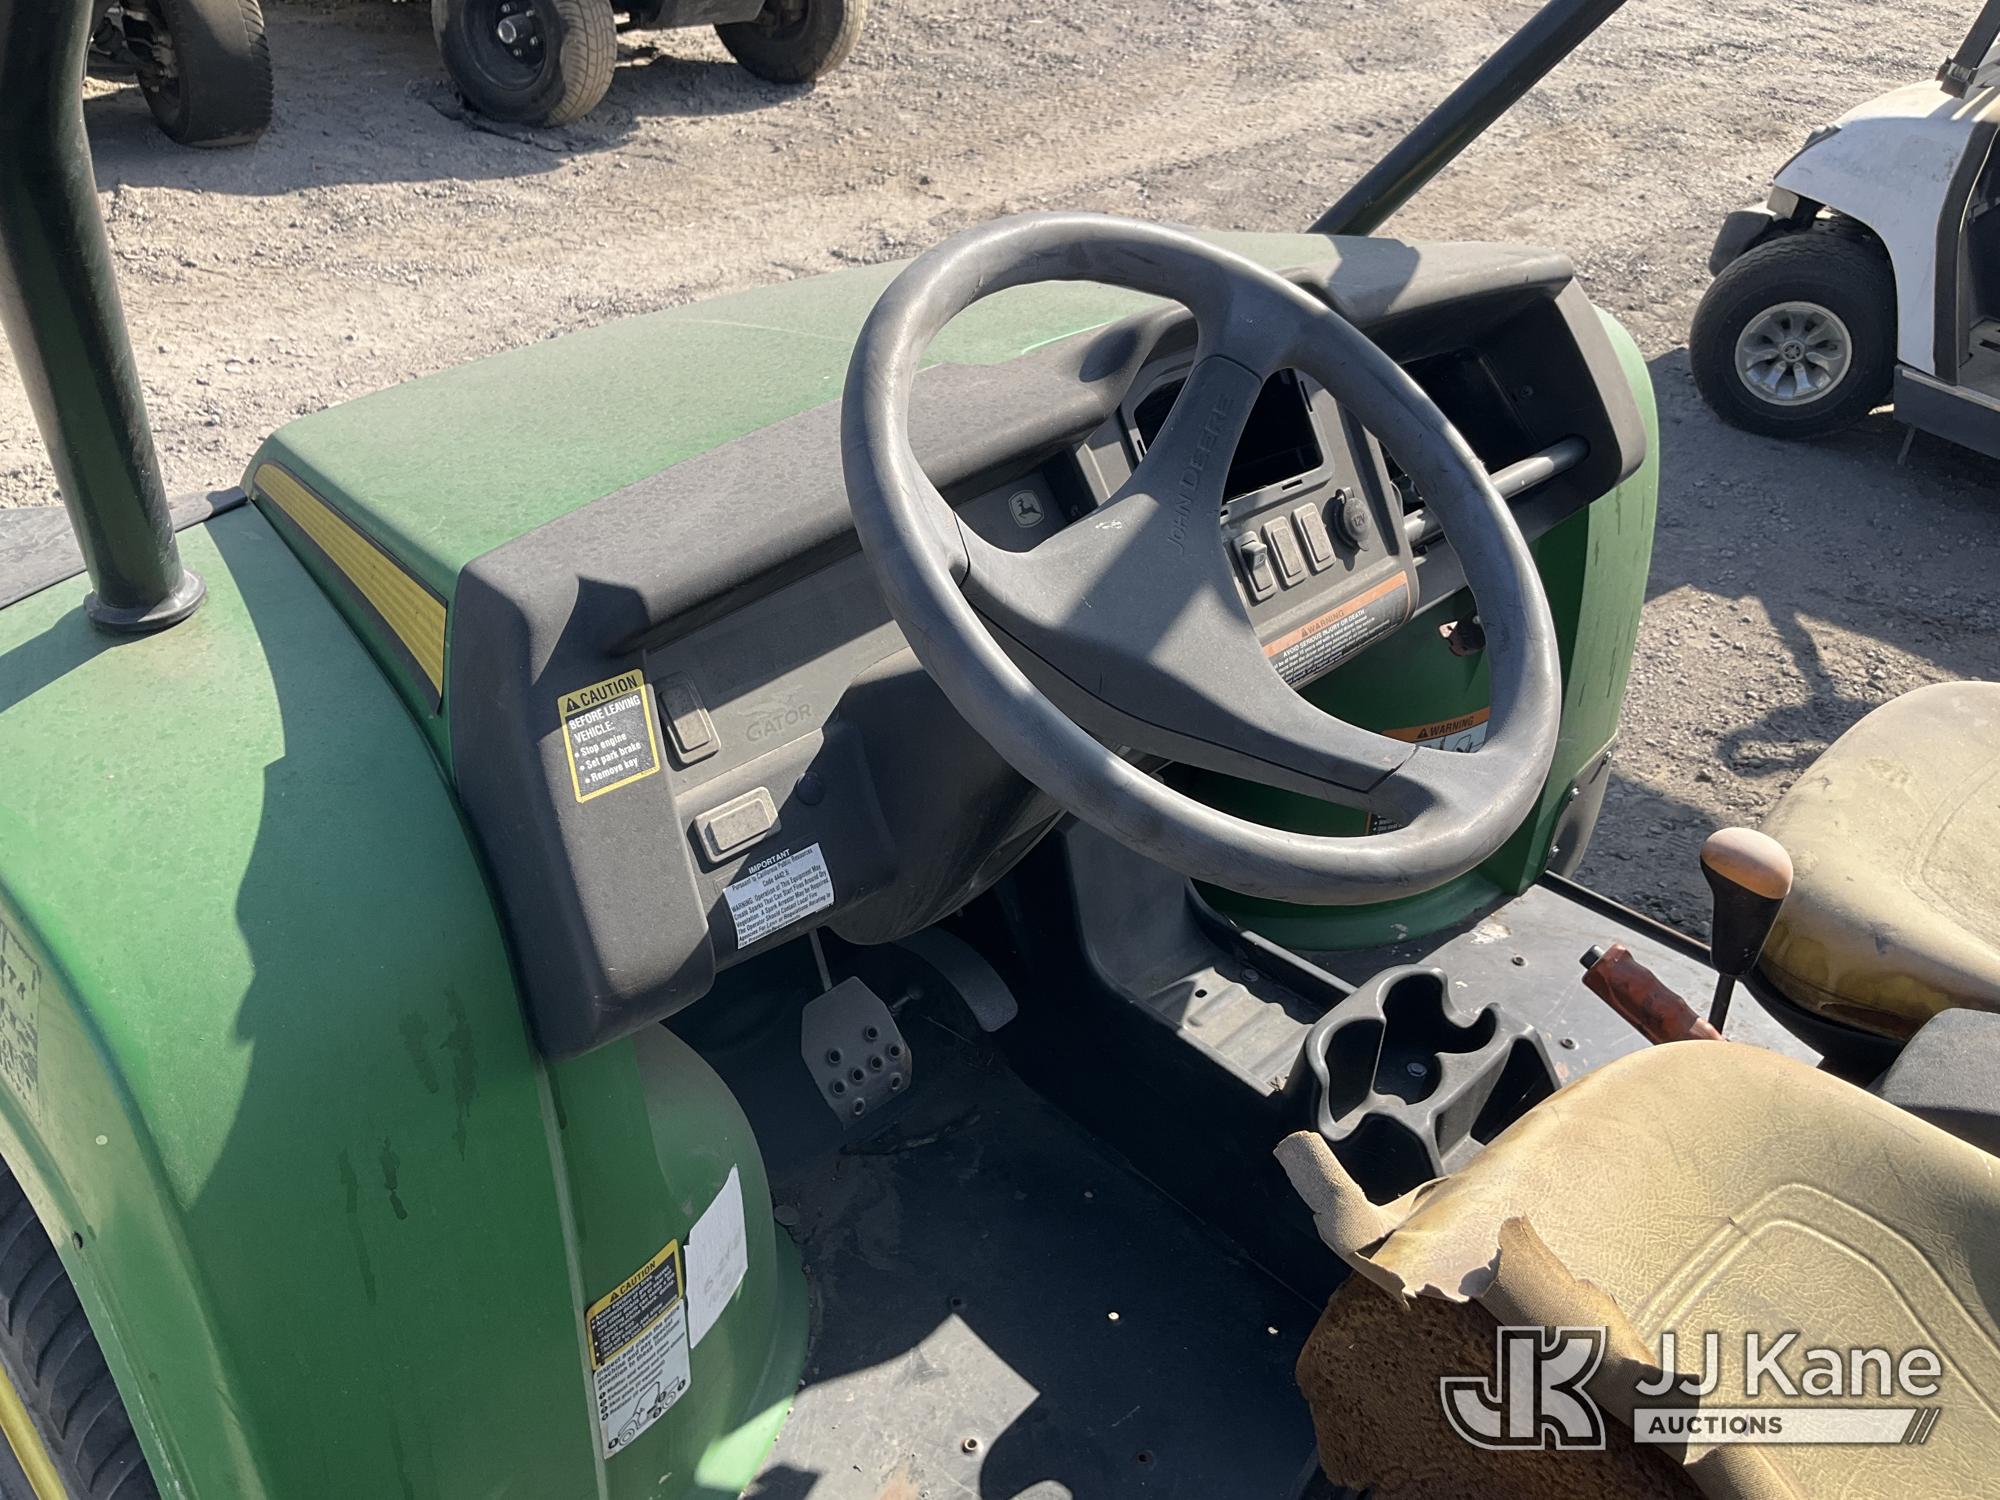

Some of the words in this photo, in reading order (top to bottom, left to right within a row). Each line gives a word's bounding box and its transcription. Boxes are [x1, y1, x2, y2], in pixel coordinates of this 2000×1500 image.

[1282, 646, 1298, 656] AVOID
[1298, 633, 1322, 647] SERIOUS
[1321, 623, 1340, 634] INJURY
[1348, 609, 1365, 620] DEATH
[1307, 609, 1345, 635] WARNING
[580, 675, 638, 706] CAUTION
[569, 709, 604, 730] BEFORE
[605, 695, 641, 716] LEAVING
[746, 703, 812, 741] GATOR
[1430, 716, 1474, 736] WARNING
[574, 721, 616, 743] VEHICLE:
[580, 744, 599, 757] Stop
[601, 733, 627, 749] engine
[586, 759, 599, 770] Set
[600, 750, 619, 765] park
[619, 741, 642, 754] brake
[591, 763, 623, 782] Remove
[624, 757, 639, 768] key
[749, 849, 790, 874] IMPORTANT
[620, 1260, 656, 1295] CAUTION
